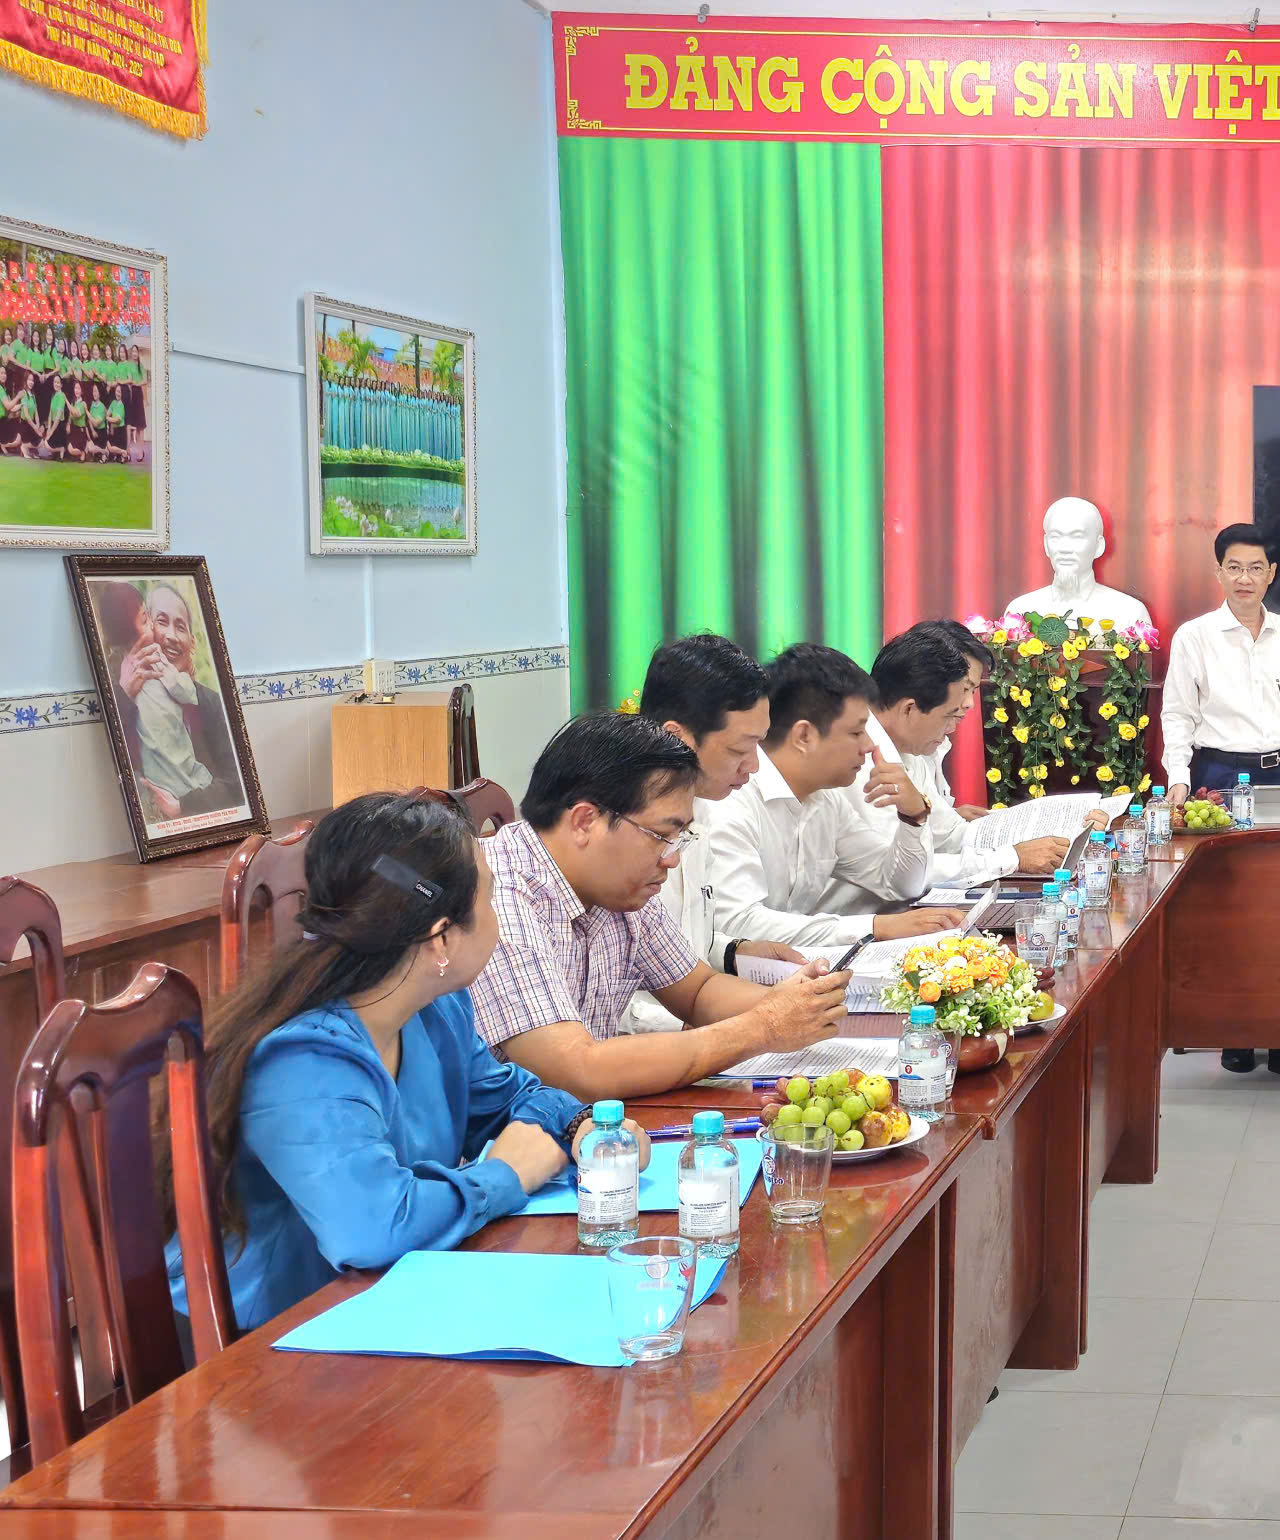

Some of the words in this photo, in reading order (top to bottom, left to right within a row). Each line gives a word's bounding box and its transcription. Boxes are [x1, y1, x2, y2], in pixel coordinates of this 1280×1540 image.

[624, 36, 805, 113] ĐẢNG
[820, 44, 996, 129] CỘNG
[1013, 43, 1139, 119] SẢN
